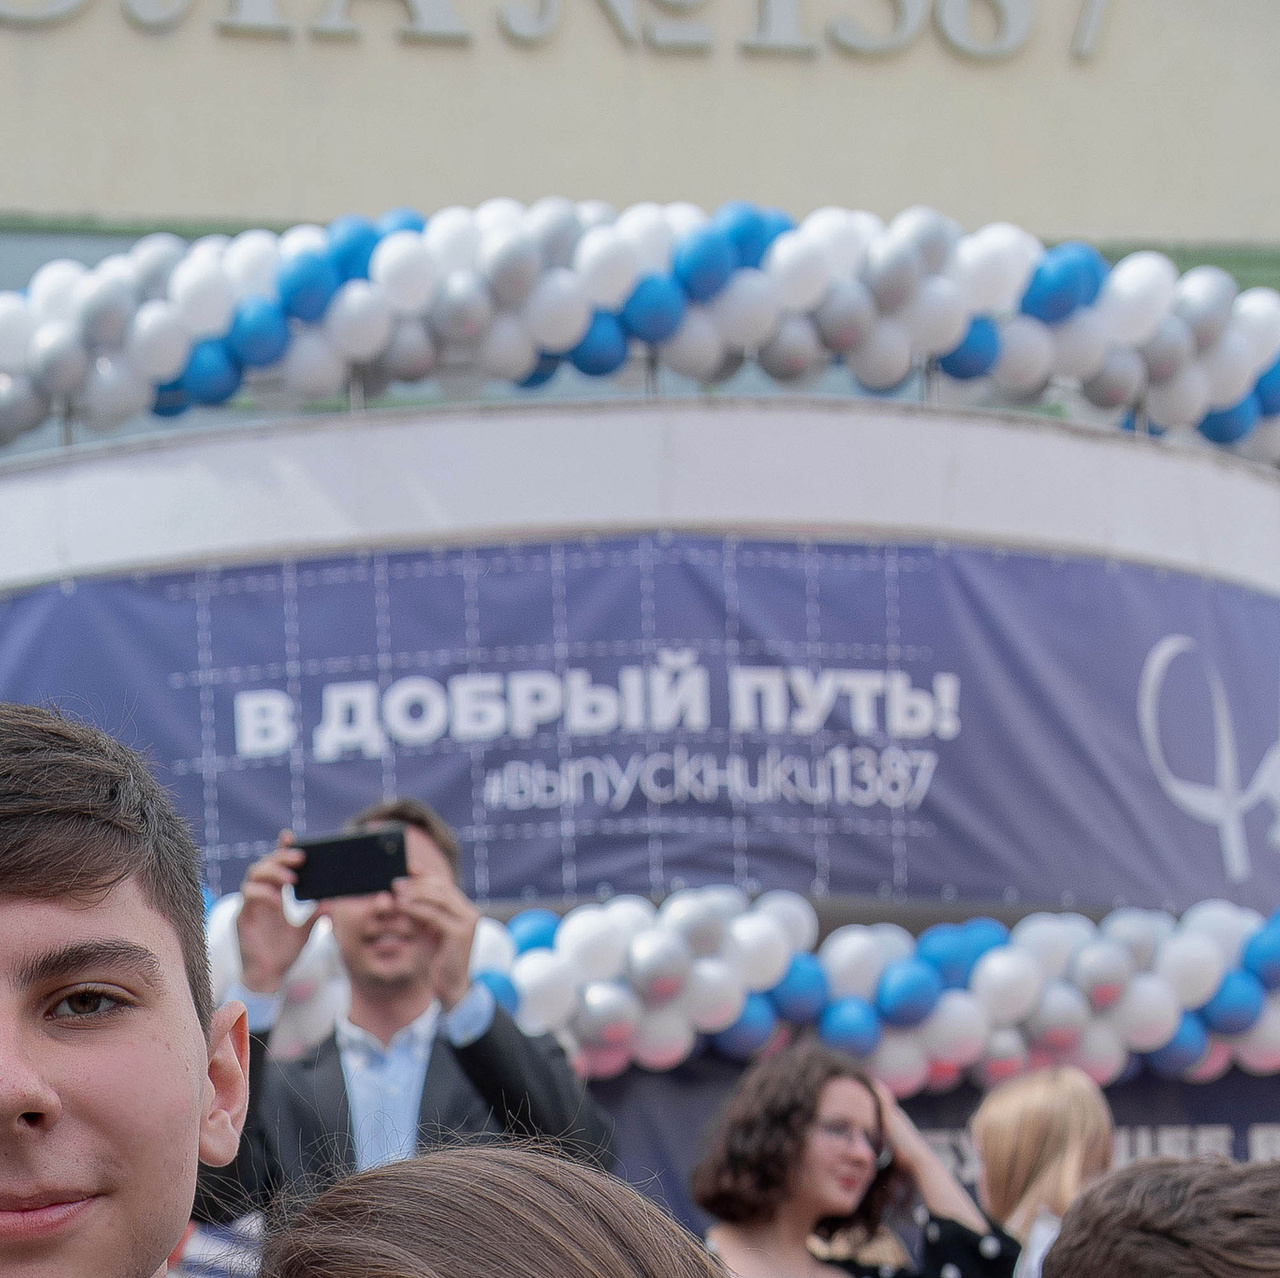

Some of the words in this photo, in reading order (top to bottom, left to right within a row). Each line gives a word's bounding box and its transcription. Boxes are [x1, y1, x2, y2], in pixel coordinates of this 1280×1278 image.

[232, 687, 298, 760] В
[311, 648, 711, 763] ДОБРЫЙ
[729, 664, 961, 741] ПУТЬ!
